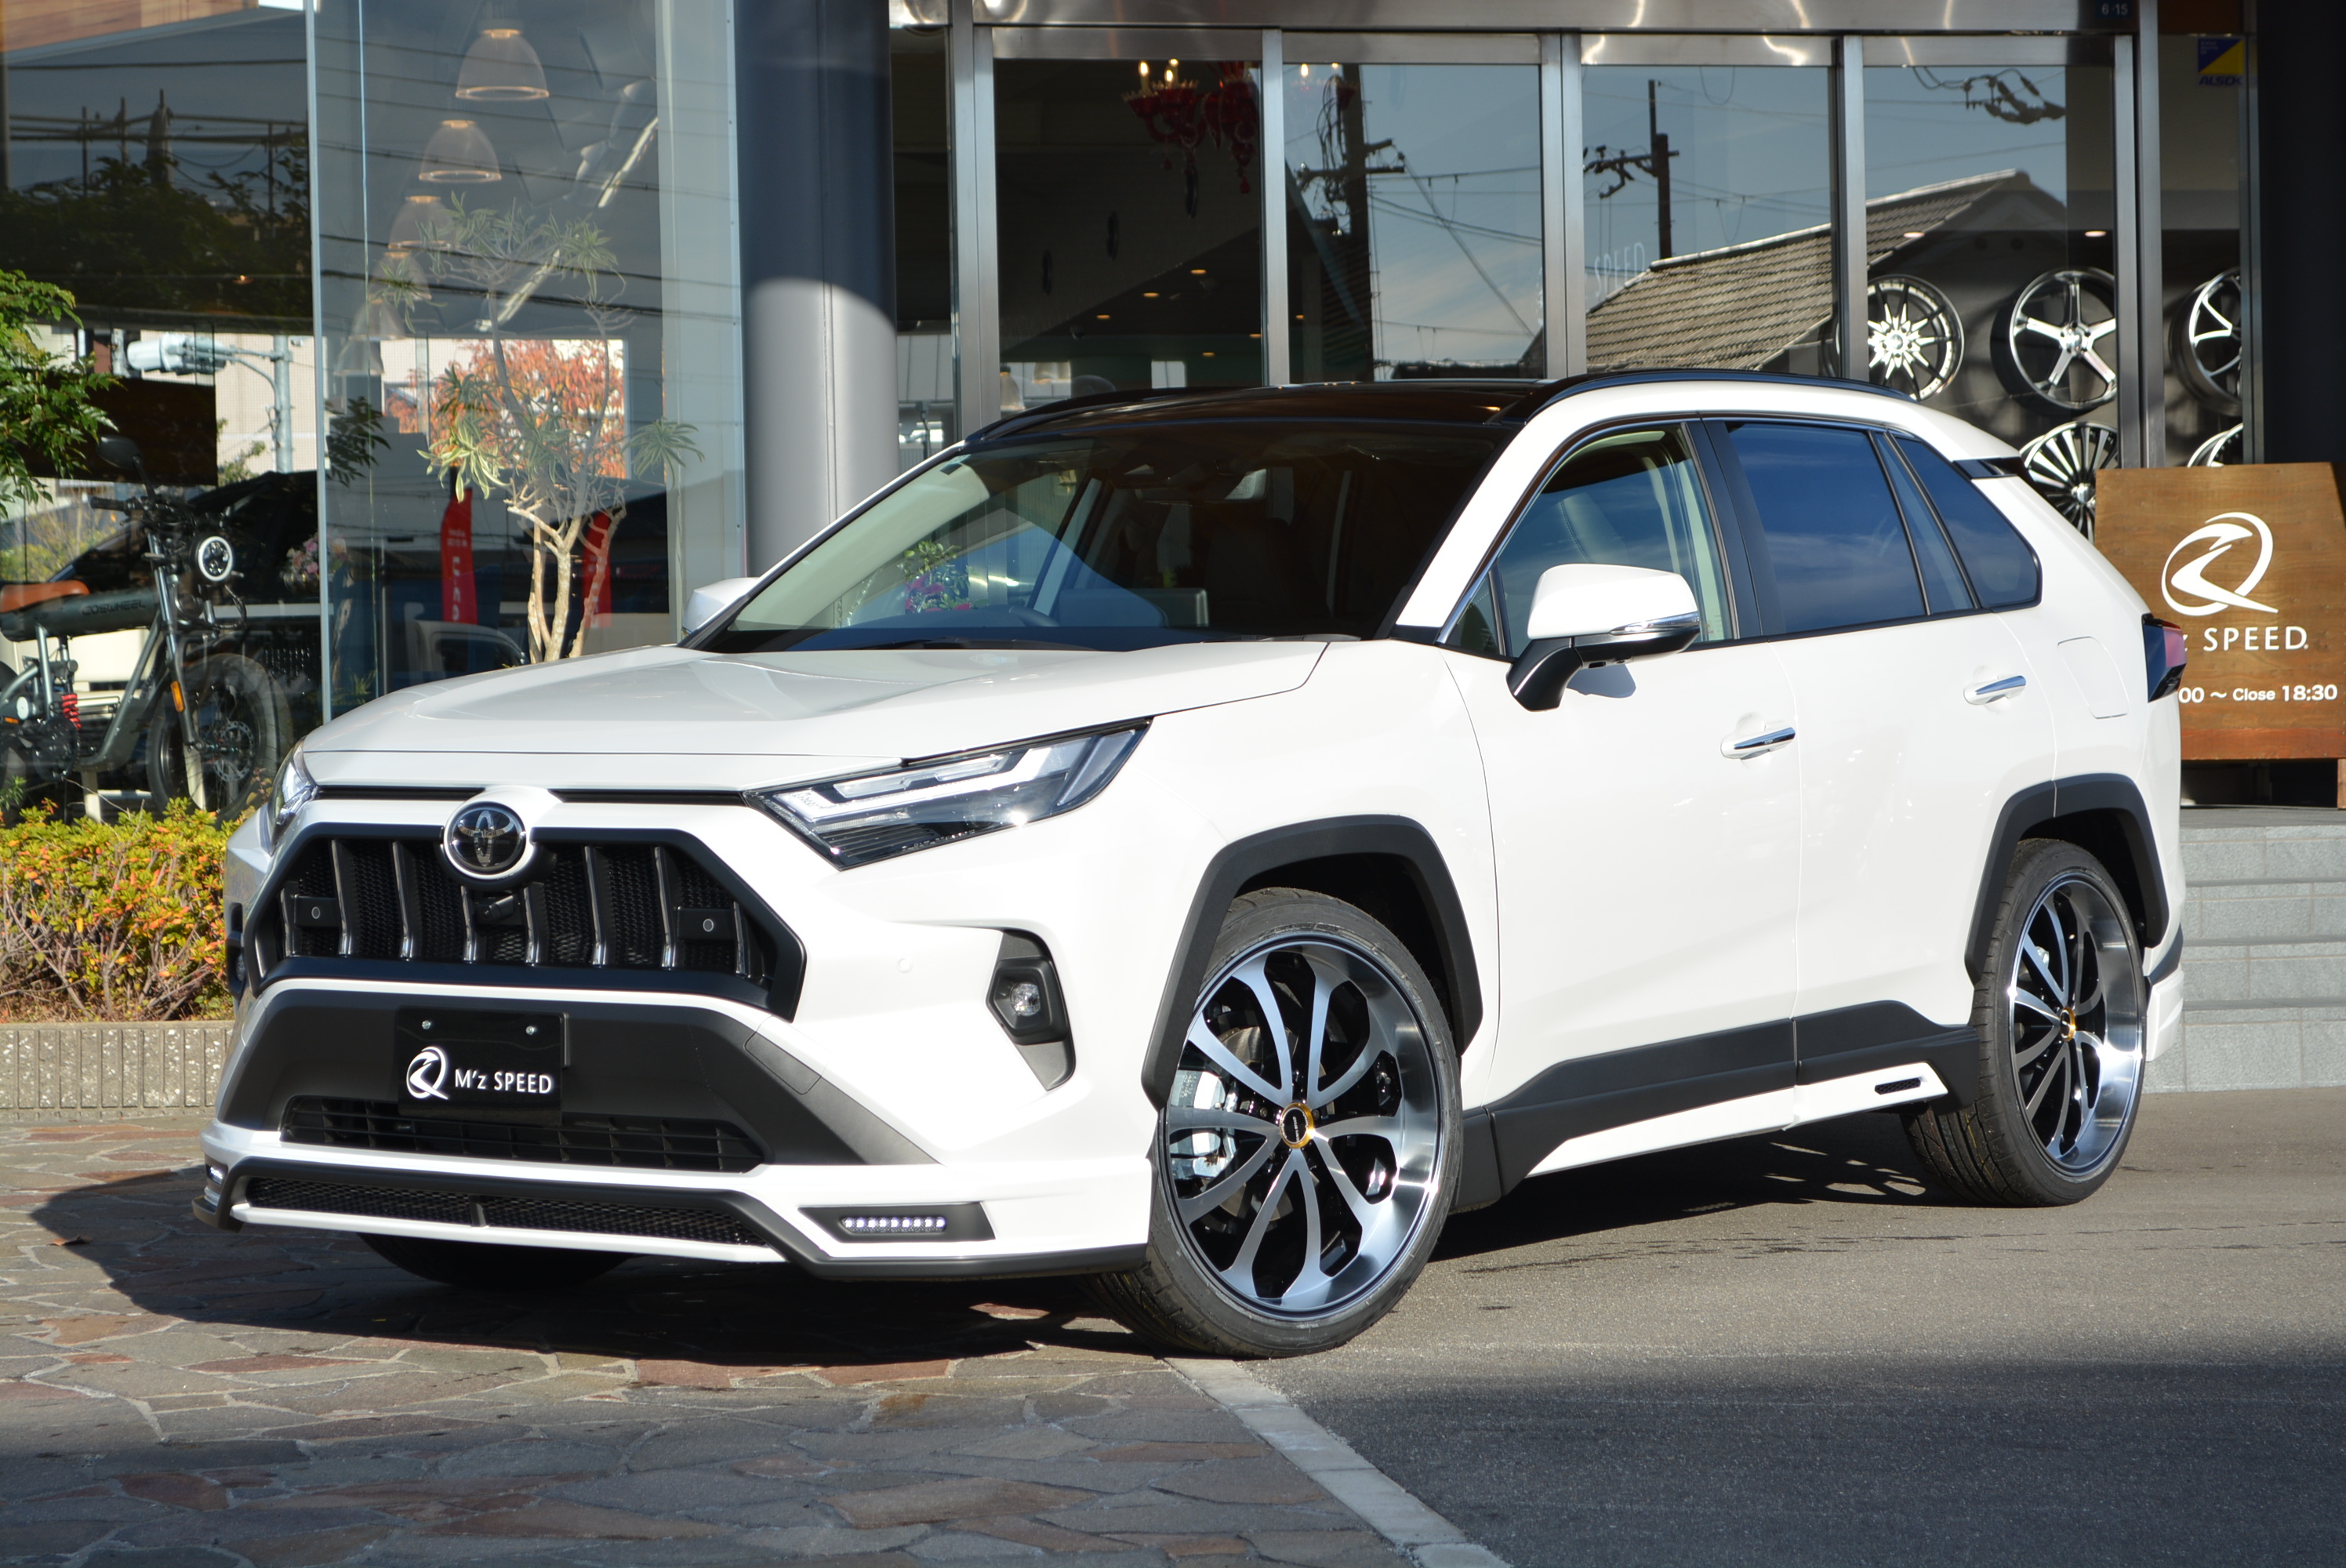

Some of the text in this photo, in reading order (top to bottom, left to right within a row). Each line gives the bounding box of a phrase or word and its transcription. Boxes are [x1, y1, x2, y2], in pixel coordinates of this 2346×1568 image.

[2232, 688, 2276, 702] Close
[2282, 684, 2338, 702] 18:30
[455, 1068, 553, 1094] M'z SPEED
